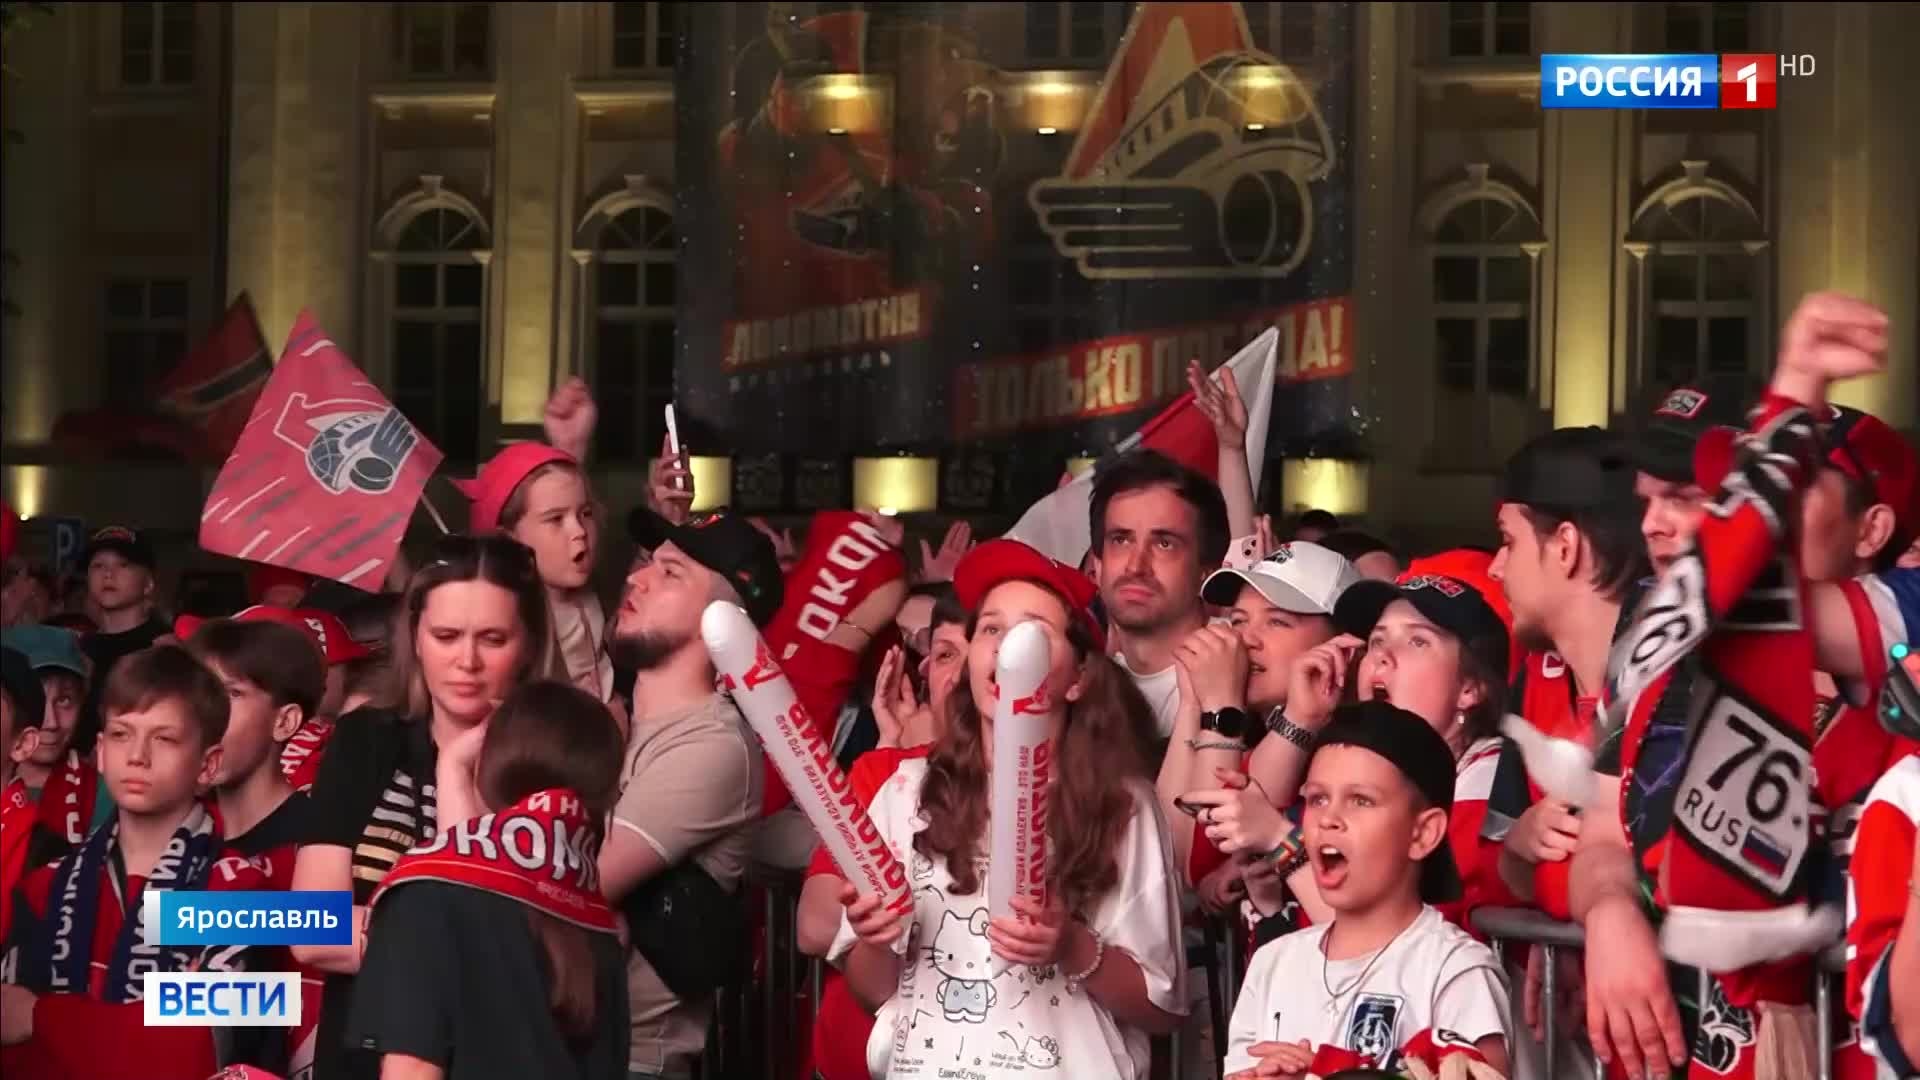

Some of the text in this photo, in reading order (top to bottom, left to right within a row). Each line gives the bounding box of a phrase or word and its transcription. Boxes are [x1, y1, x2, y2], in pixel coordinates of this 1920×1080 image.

[973, 342, 1142, 430] ТОЛЬКО
[1706, 714, 1802, 824] 76
[1683, 788, 1743, 846] RUS
